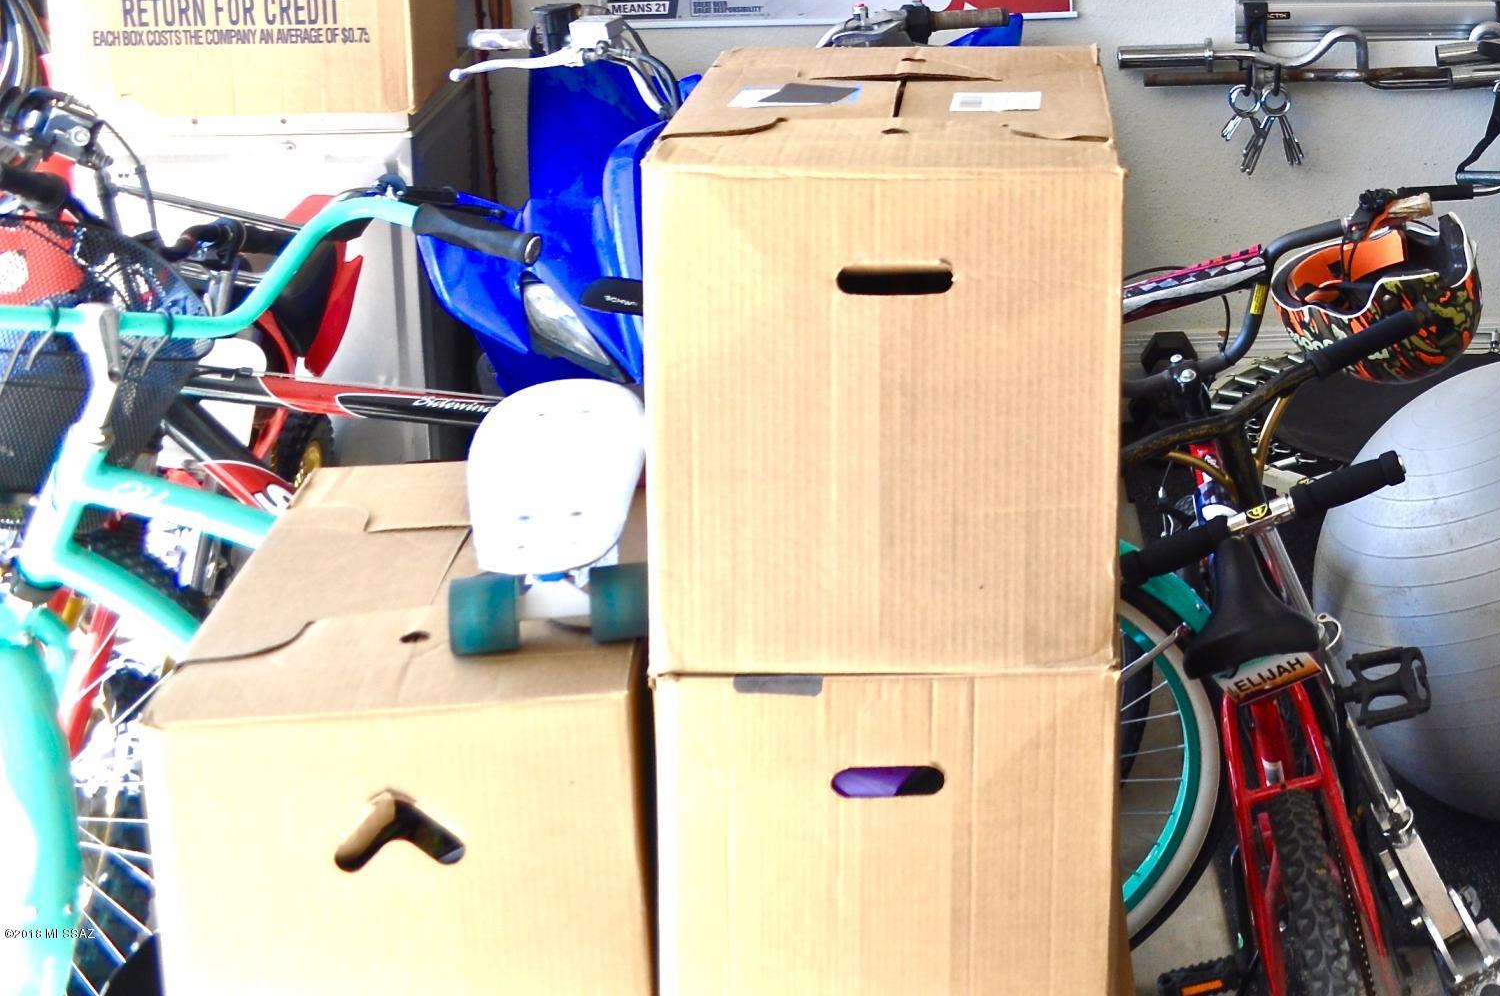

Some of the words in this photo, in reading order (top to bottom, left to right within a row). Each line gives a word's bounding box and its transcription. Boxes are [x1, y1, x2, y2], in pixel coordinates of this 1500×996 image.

[612, 3, 652, 14] MEANS
[655, 2, 667, 13] 21
[93, 30, 120, 46] EACH
[122, 30, 145, 46] BOX
[146, 29, 182, 46] COSTS
[183, 29, 203, 45] THE
[205, 28, 256, 45] COMPANY
[259, 28, 275, 44] AN
[276, 27, 324, 44] AVERAGE
[326, 27, 339, 44] OF
[1234, 657, 1304, 693] ELIJAH
